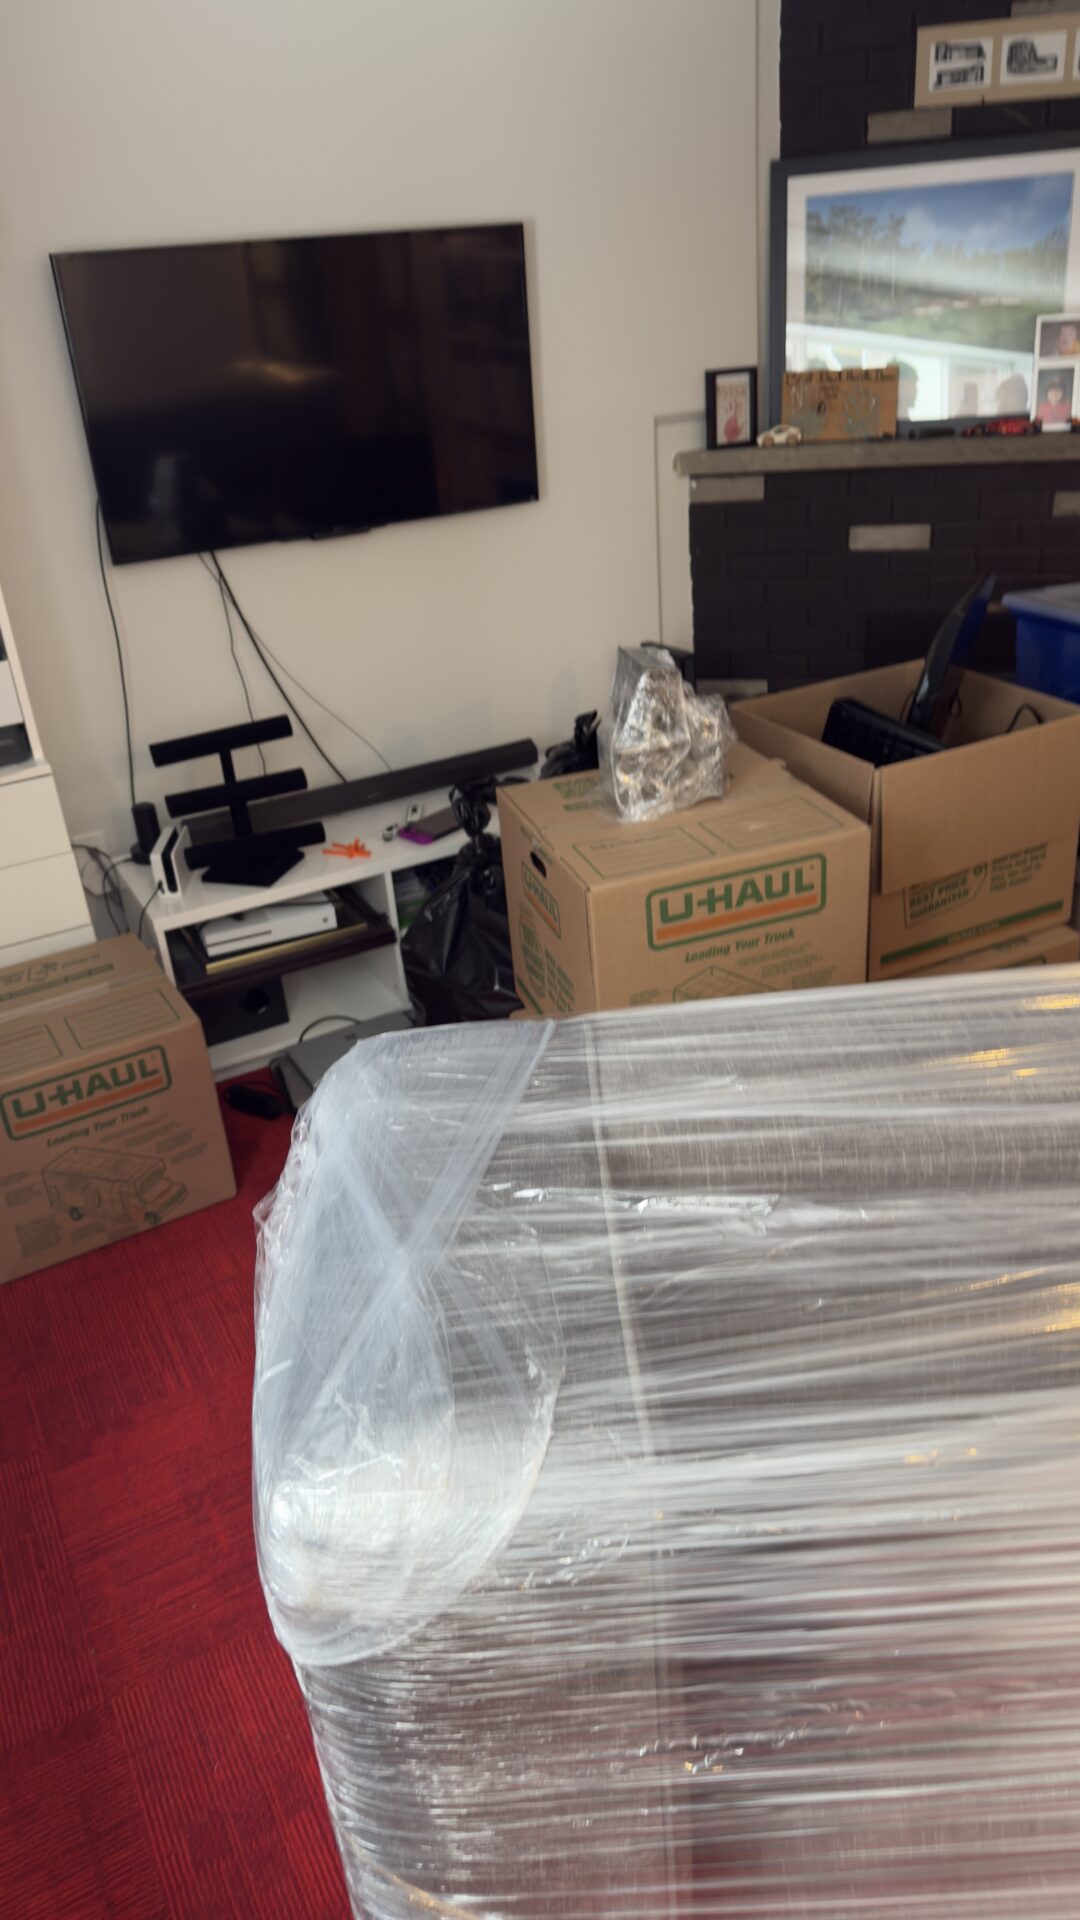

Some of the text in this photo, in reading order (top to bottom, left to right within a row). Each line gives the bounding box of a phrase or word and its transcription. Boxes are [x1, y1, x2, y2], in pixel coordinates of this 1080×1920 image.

[660, 868, 815, 924] U-HAUL
[684, 927, 796, 963] Loading Your Truck
[11, 1058, 160, 1120] U-HAUL
[47, 1127, 90, 1147] Loading
[93, 1118, 117, 1132] Your
[121, 1105, 149, 1122] Truck
